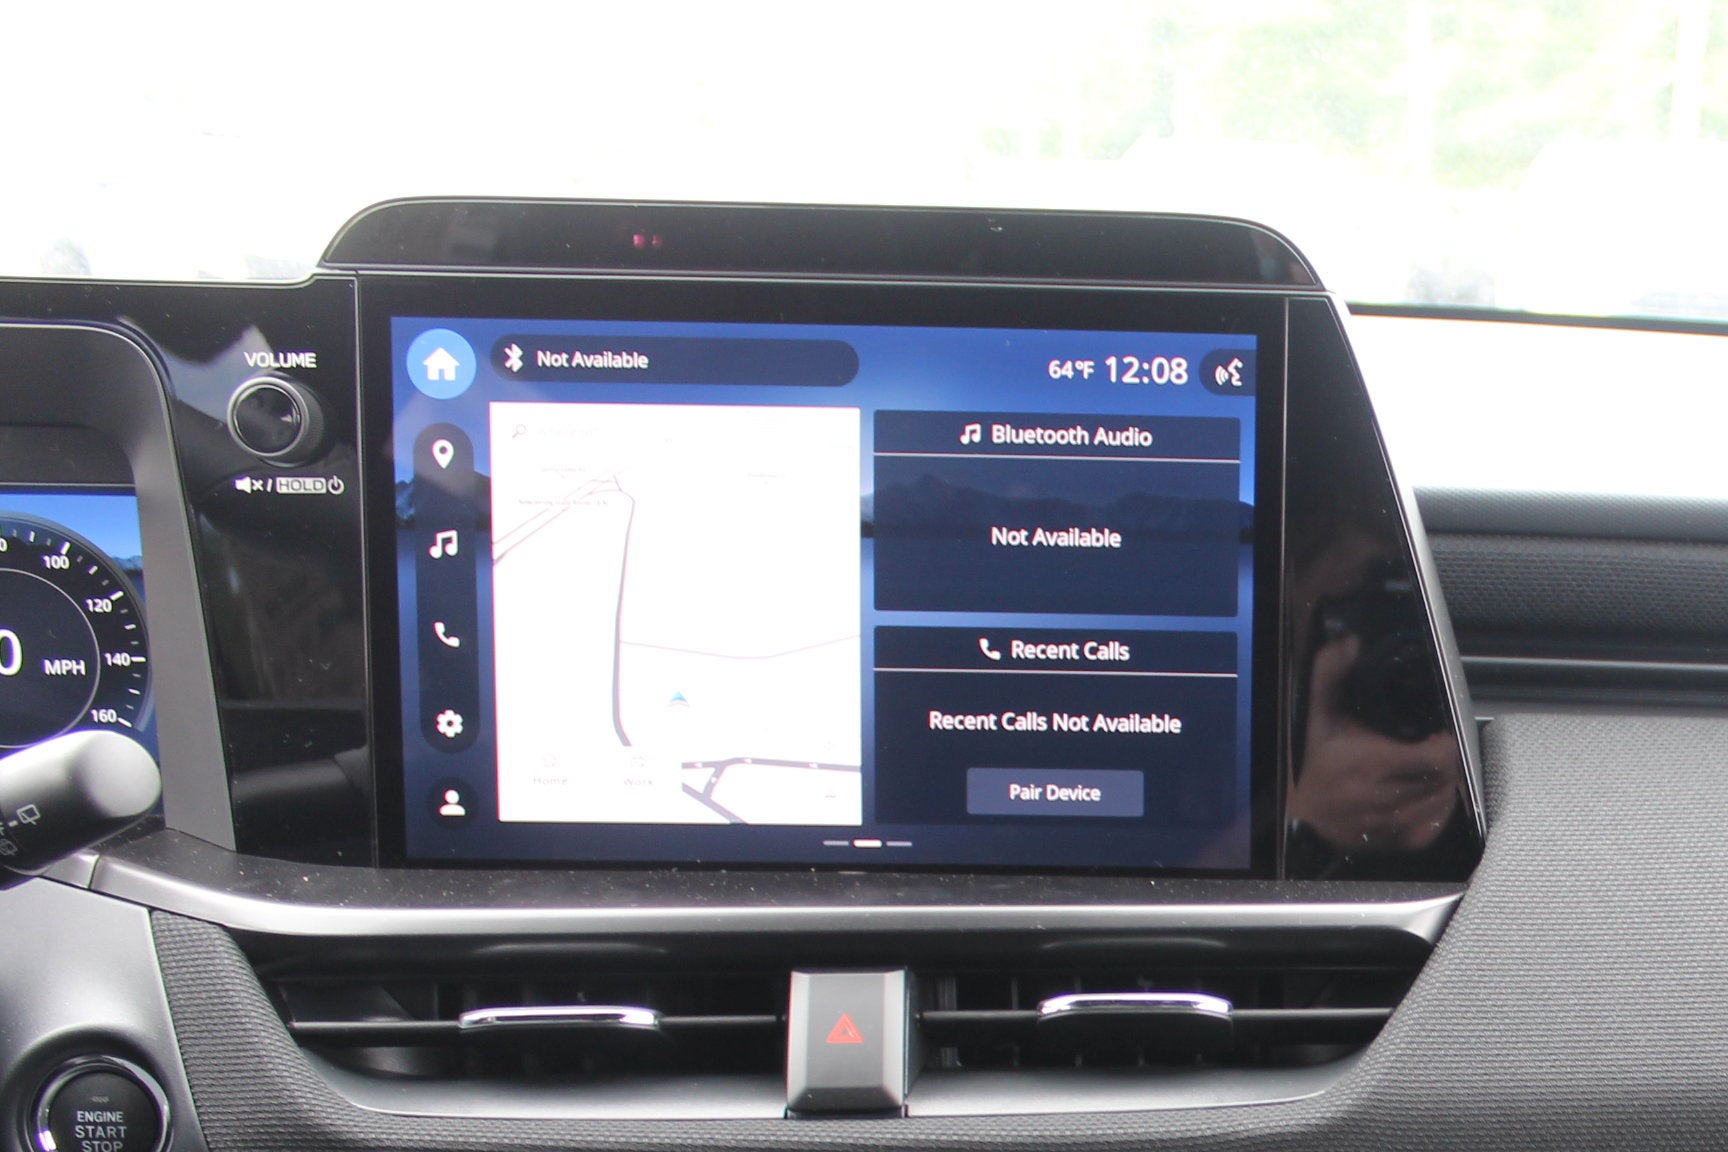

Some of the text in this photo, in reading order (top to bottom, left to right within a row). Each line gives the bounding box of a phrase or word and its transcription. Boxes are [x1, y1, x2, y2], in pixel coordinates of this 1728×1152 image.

[243, 351, 318, 369] VOLUME
[536, 350, 649, 368] Not Available
[1104, 355, 1189, 385] 12:08
[991, 424, 1153, 447] Bluetooth Audio
[277, 478, 324, 493] HOLD
[990, 526, 1122, 548] Not Available
[42, 555, 70, 570] 100
[85, 598, 113, 613] 120
[104, 652, 131, 666] 140
[1010, 640, 1130, 661] Recent Calls
[44, 659, 86, 676] MPH
[91, 708, 118, 723] 160
[928, 710, 1182, 734] Recent Calls Not Available
[1009, 784, 1102, 802] Pair Device
[76, 1110, 124, 1122] ENGINE
[75, 1126, 127, 1138] START
